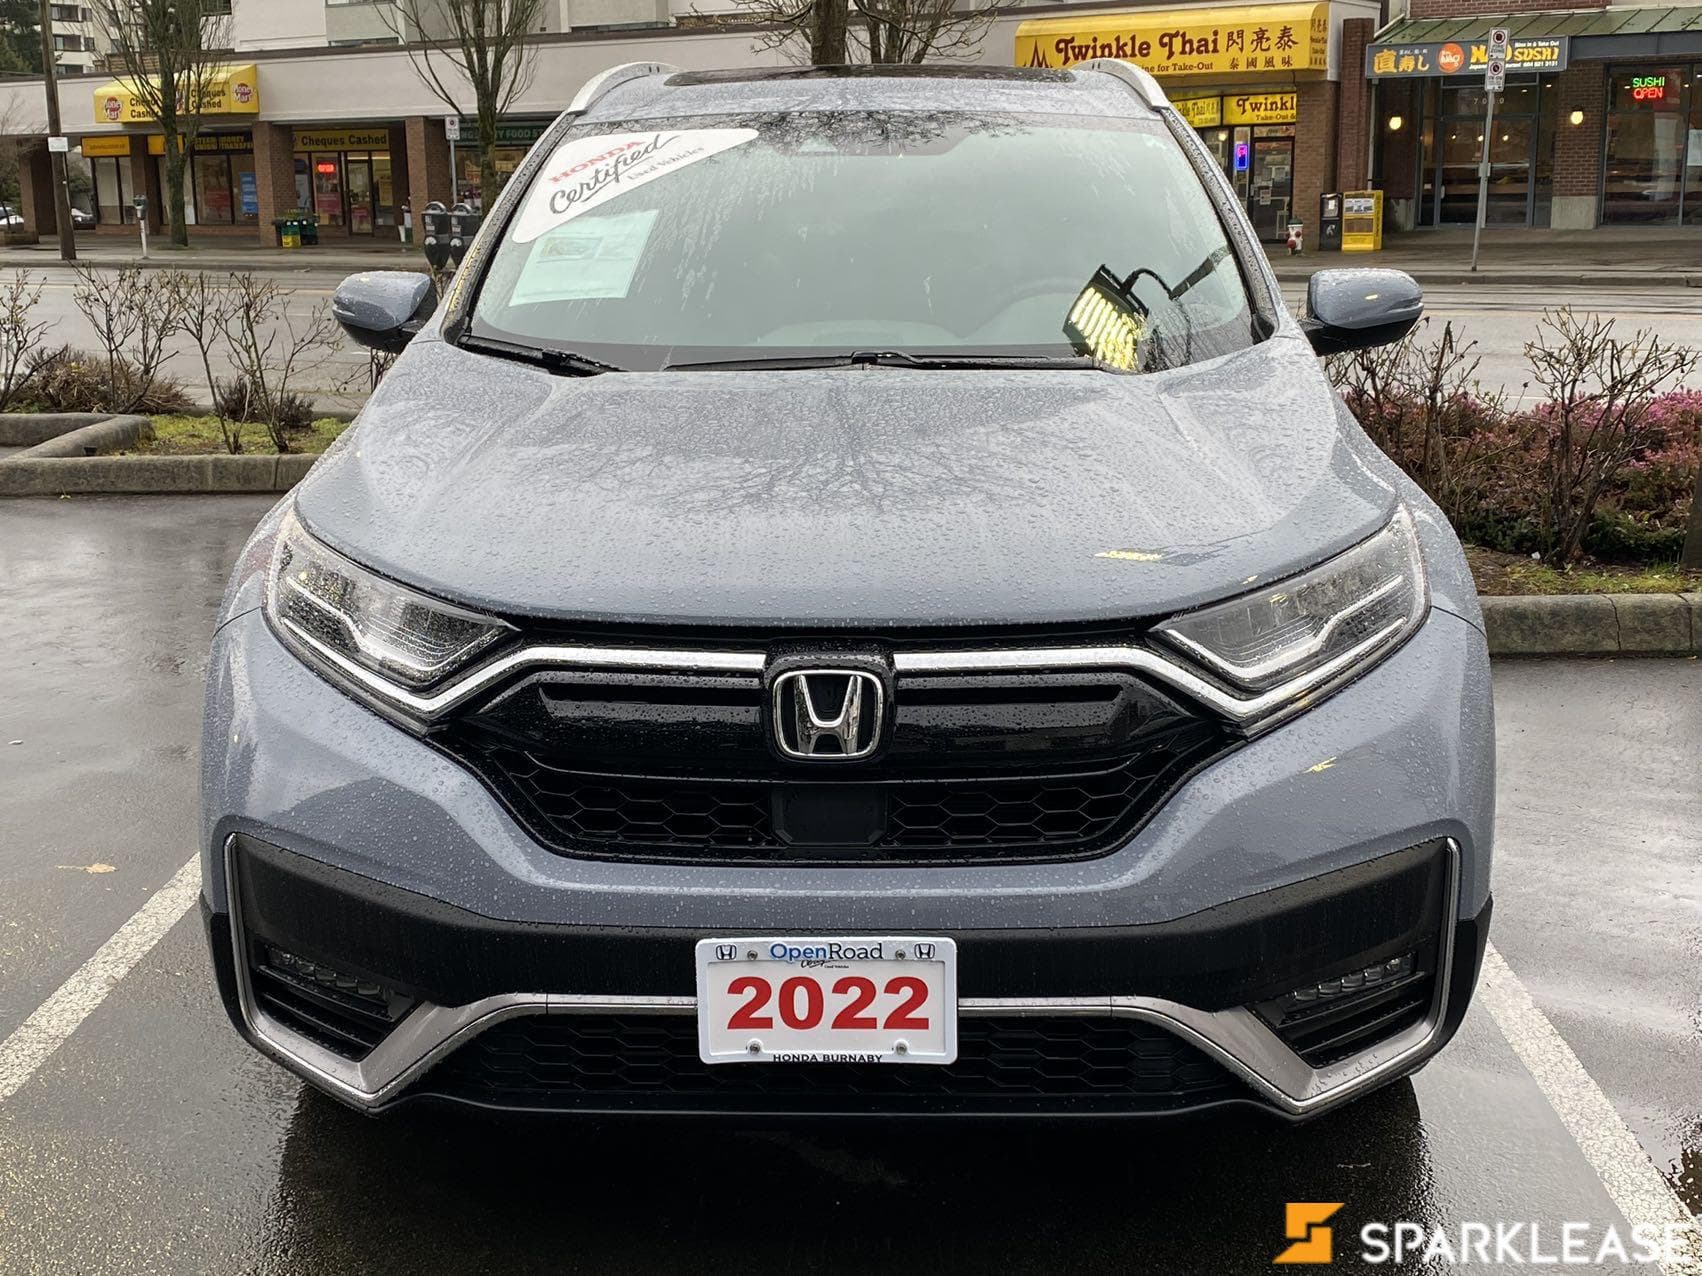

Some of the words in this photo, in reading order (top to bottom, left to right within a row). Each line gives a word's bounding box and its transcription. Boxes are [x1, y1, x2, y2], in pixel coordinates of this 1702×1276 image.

[1226, 25, 1299, 53] 閃亮泰
[1055, 34, 1152, 65] Twinkle
[1159, 29, 1220, 60] Thai
[1514, 47, 1559, 61] SUSHI
[1157, 64, 1170, 72] for
[1171, 61, 1213, 72] Take-Out
[1632, 76, 1665, 87] SUSHI
[1633, 87, 1663, 99] OPEN
[1236, 96, 1295, 115] Twinkl
[1473, 97, 1504, 105] 700
[301, 136, 345, 147] Cheques
[348, 134, 387, 145] Cashed
[506, 129, 532, 138] FOOD
[550, 141, 646, 182] HONDA
[549, 134, 680, 214] Certified
[770, 942, 884, 962] OpenRoad
[727, 976, 930, 1030] 2022
[773, 1054, 819, 1063] HONDA
[822, 1054, 883, 1063] BURNABY
